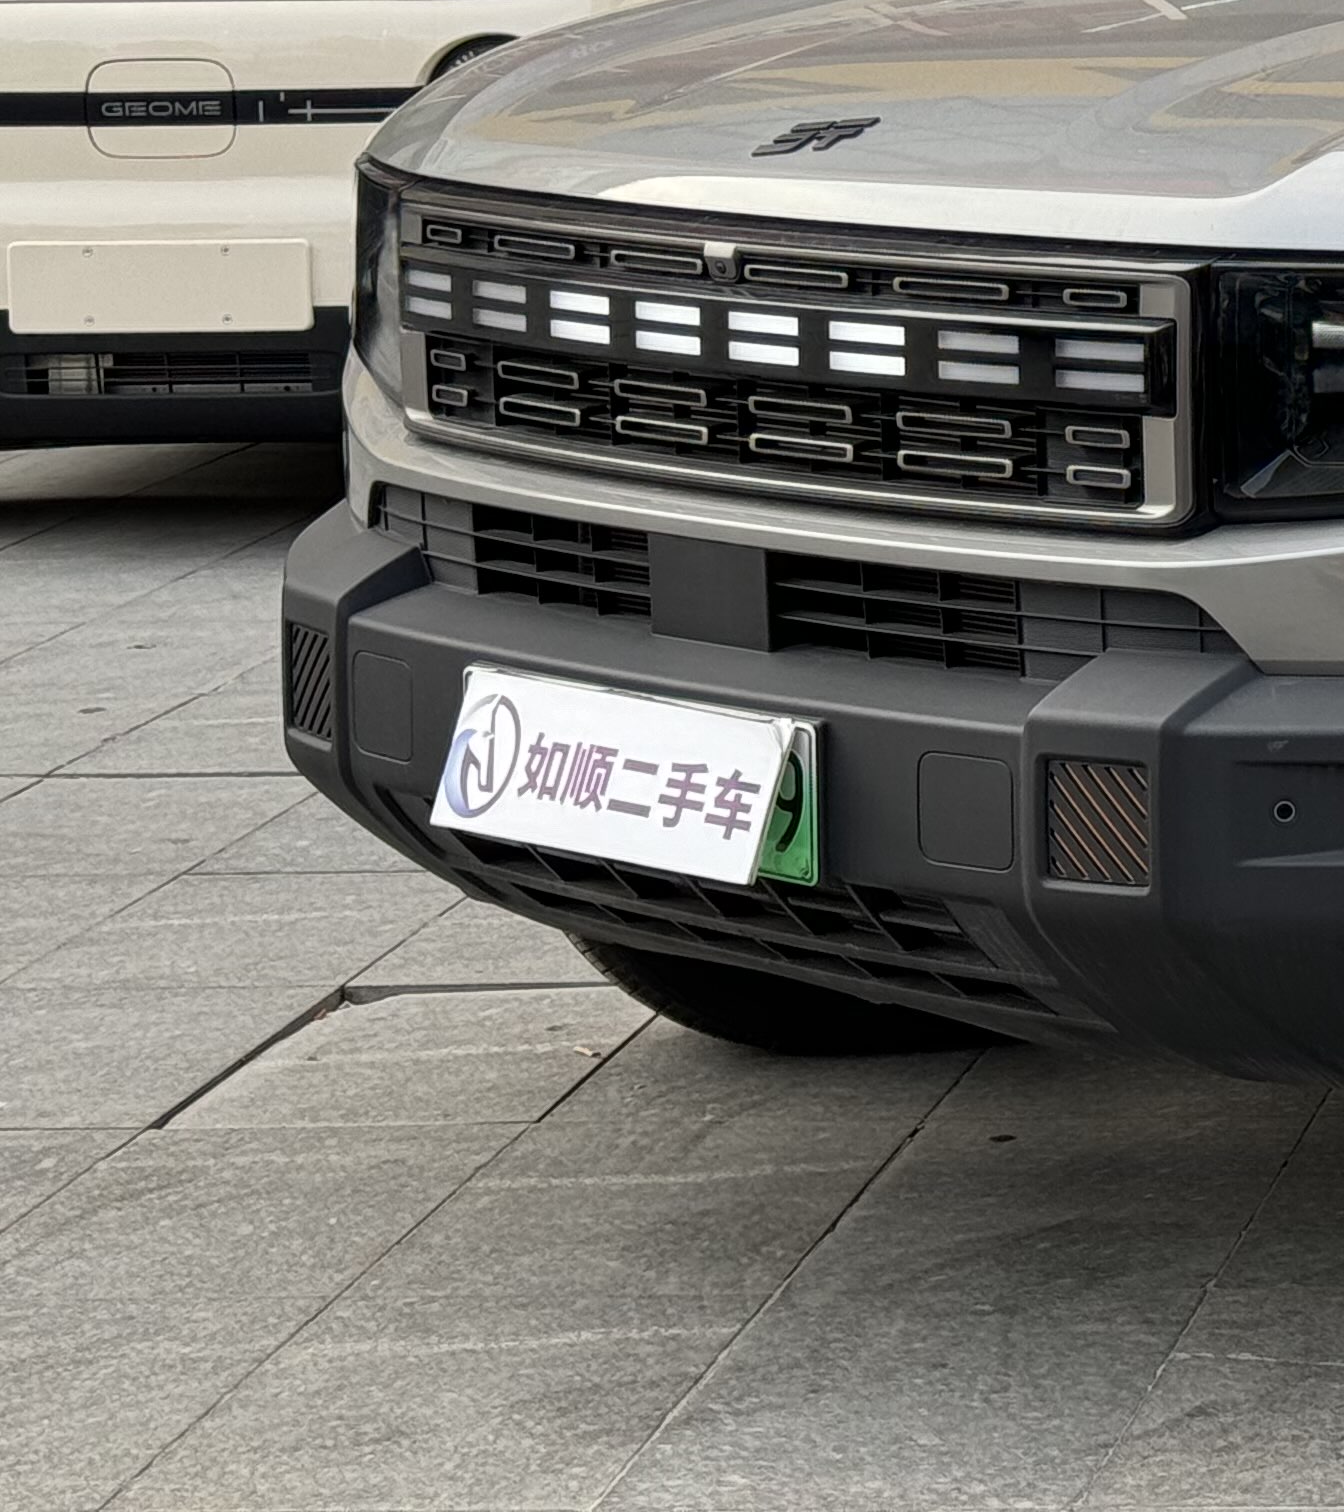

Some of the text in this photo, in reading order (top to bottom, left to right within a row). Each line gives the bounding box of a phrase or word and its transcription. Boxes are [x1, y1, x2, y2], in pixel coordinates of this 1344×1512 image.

[101, 99, 222, 118] GEOME
[518, 731, 761, 841] 如顺二手车
